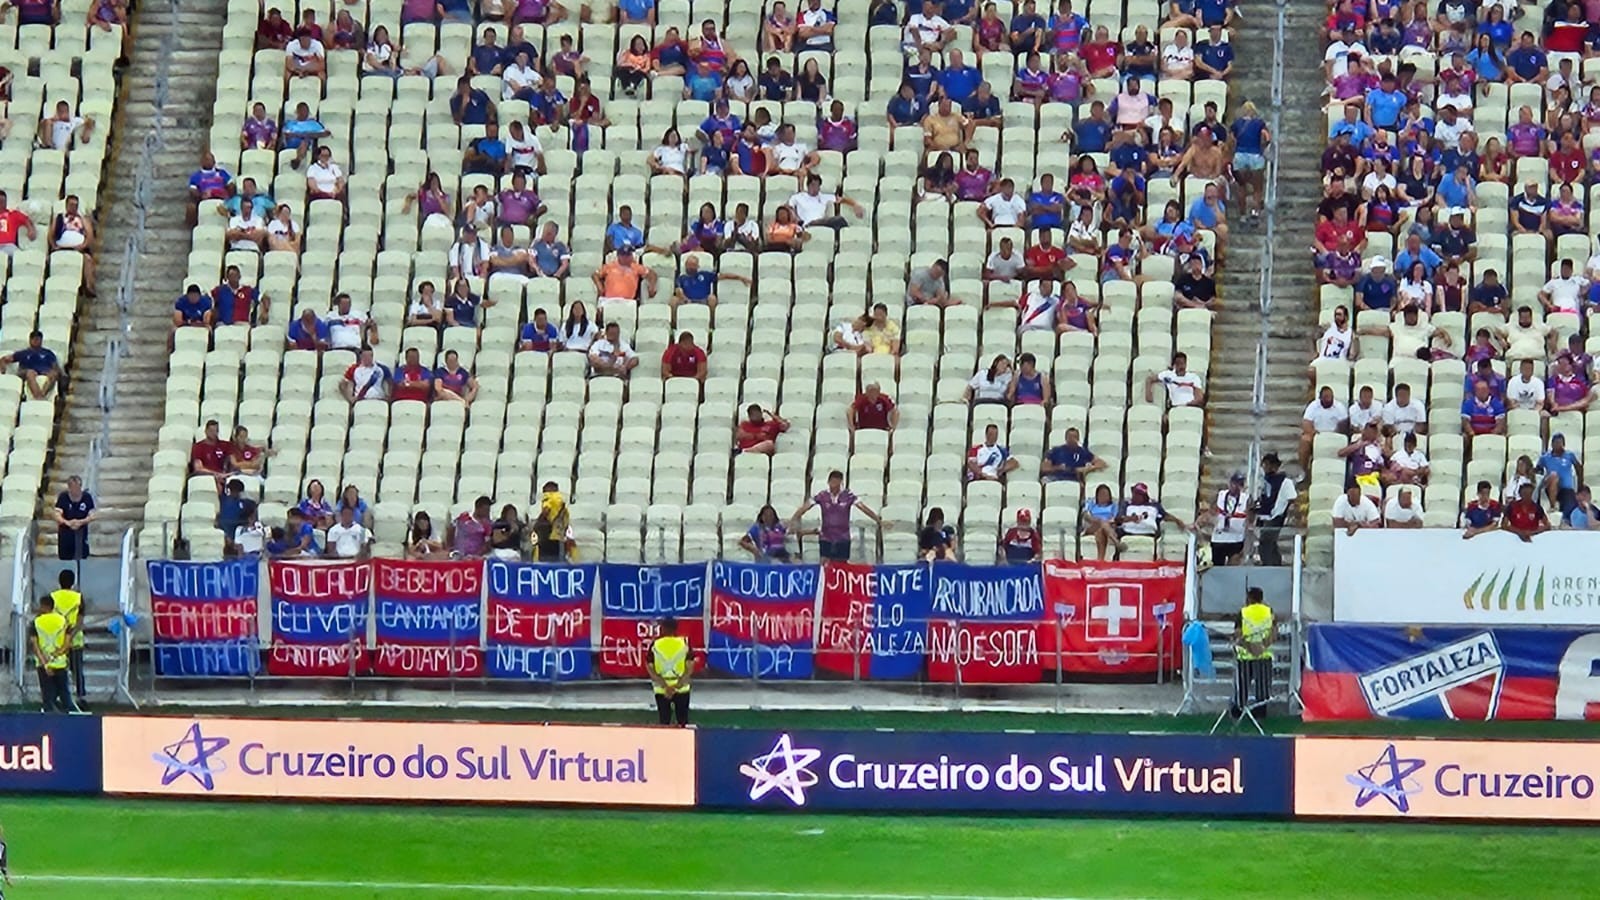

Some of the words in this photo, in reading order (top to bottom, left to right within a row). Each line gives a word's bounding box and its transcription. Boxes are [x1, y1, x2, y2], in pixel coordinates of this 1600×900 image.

[149, 562, 257, 598] CANTAMOS
[381, 564, 477, 593] BEBEMOS
[492, 563, 508, 595] O
[517, 567, 584, 598] AMOR
[639, 566, 661, 585] OS
[714, 562, 727, 588] A
[728, 567, 814, 598] LOUCURA
[827, 567, 923, 597] SOMENTE
[1552, 576, 1600, 590] AREN
[605, 577, 701, 612] LOUCOS
[932, 574, 1044, 616] ARQUIBANCADA
[1552, 592, 1600, 606] CAST
[155, 601, 199, 638] COM
[279, 601, 311, 633] EU
[316, 603, 365, 633] VOU
[382, 601, 479, 630] CANTAMOS
[496, 604, 522, 637] DE
[534, 608, 583, 640] UMA
[713, 595, 743, 633] DA
[751, 607, 812, 640] MINHA
[847, 600, 904, 628] PELO
[725, 637, 794, 676] VIDA
[1370, 641, 1494, 701] FORTALEZA
[239, 743, 396, 778] Cruzeiro
[403, 744, 448, 779] do
[455, 745, 511, 780] Sul
[520, 748, 648, 783] Virtual
[828, 754, 990, 791] Cruzeiro
[995, 754, 1043, 791] do
[1049, 755, 1106, 792] Sul
[1113, 757, 1244, 794] Virtual
[1434, 764, 1594, 799] Cruzeiro
